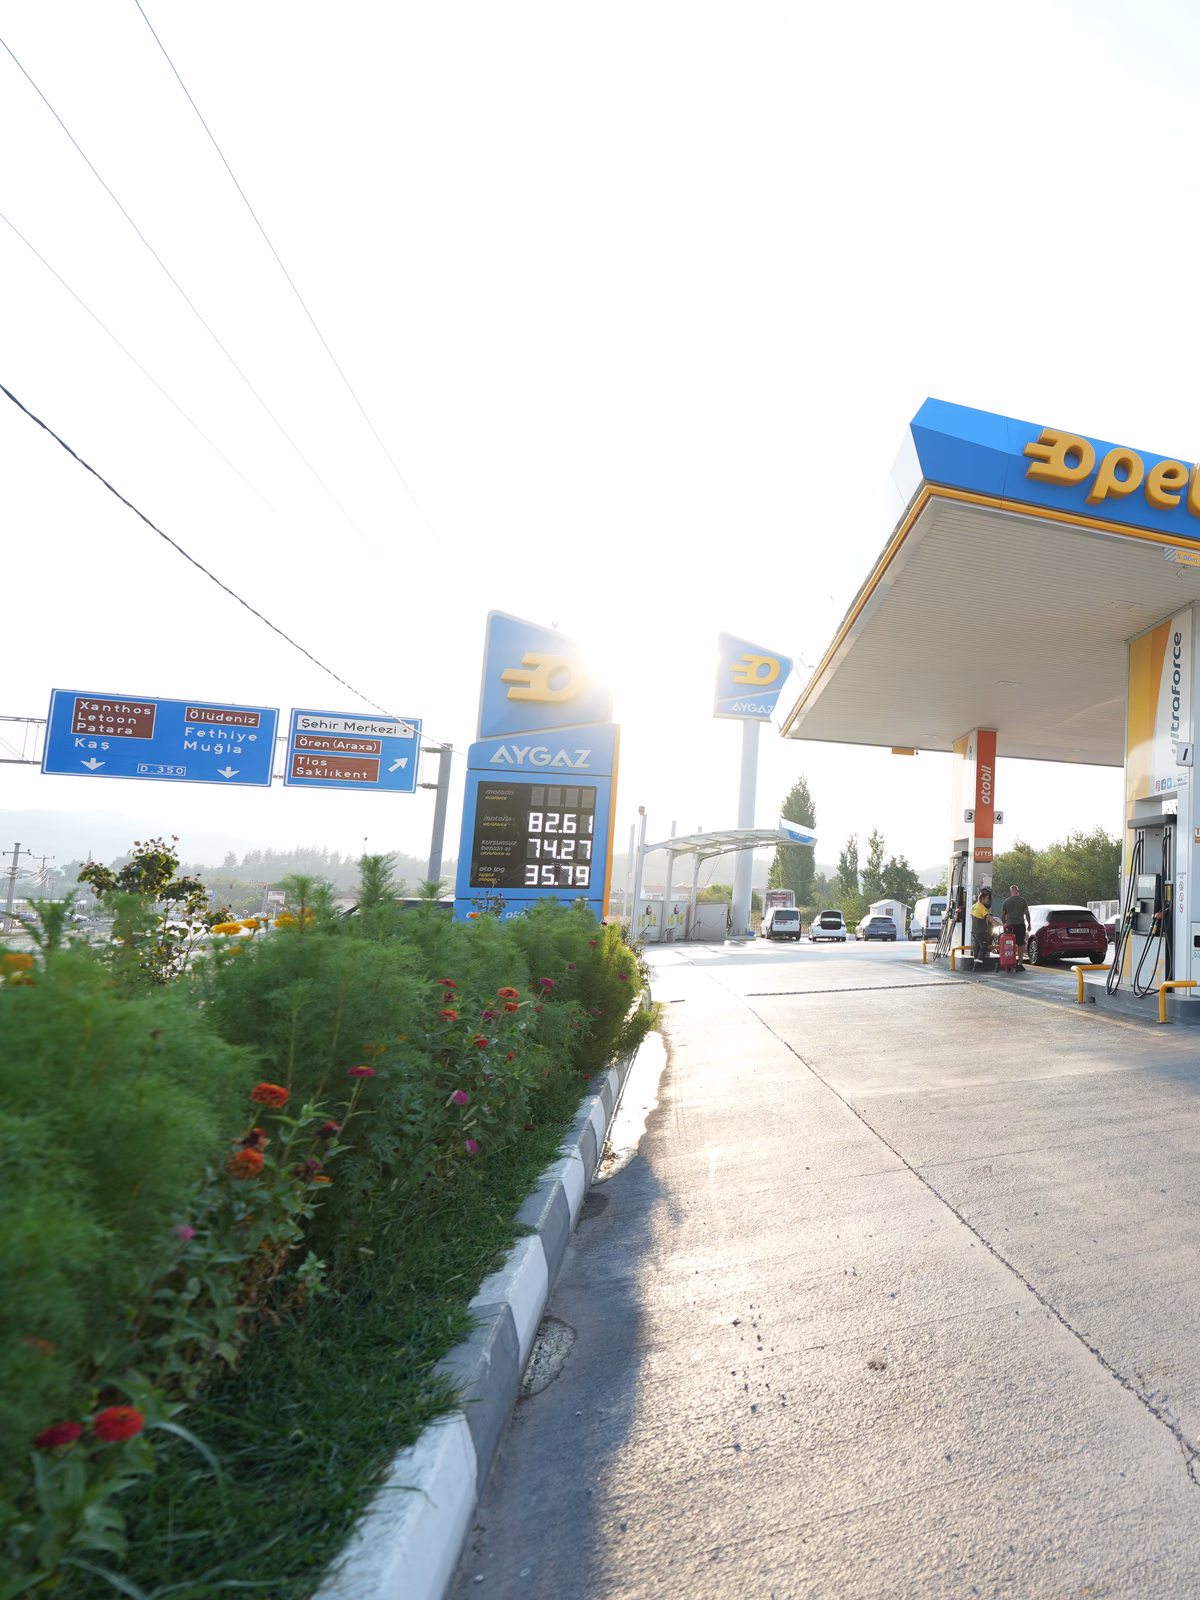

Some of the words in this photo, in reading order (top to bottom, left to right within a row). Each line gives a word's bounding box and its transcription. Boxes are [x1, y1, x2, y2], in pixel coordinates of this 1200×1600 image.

[80, 701, 151, 714] Xanthos
[731, 702, 776, 714] AYGAZ
[78, 712, 136, 724] Letoon
[190, 709, 256, 724] Ölüdeniz
[76, 722, 132, 734] Patara
[301, 718, 338, 728] Şehir
[344, 722, 396, 734] Merkezi
[184, 727, 258, 742] Fethiye
[74, 738, 110, 750] Kaş
[184, 740, 242, 754] Muğla
[300, 737, 330, 748] Ören
[333, 740, 377, 751] (Araxa)
[298, 756, 327, 766] Tlos
[489, 744, 592, 768] AYGAZ
[296, 766, 368, 778] Saklıkent
[982, 765, 992, 804] otobil
[528, 812, 593, 834] 82.61
[967, 812, 973, 820] 3
[528, 839, 592, 859] 74.27
[524, 865, 590, 886] 35.79
